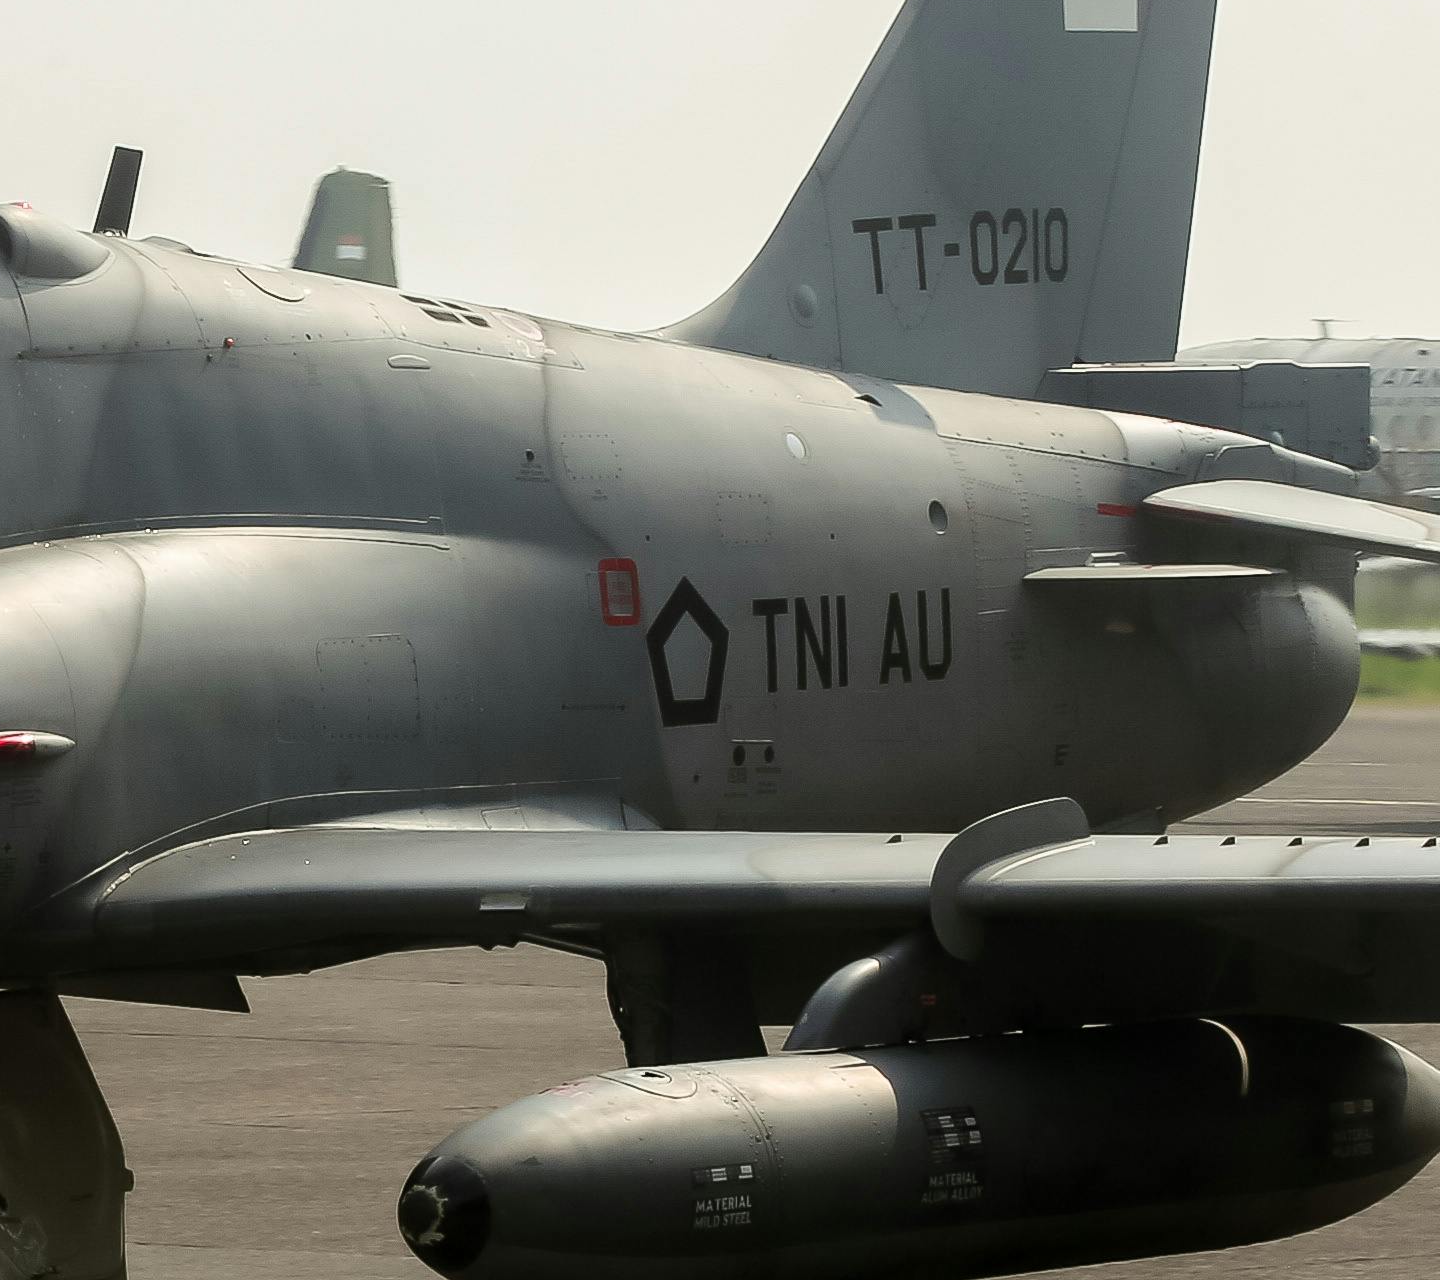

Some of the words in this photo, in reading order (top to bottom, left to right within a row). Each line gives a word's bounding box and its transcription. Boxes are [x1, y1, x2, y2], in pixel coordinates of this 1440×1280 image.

[851, 207, 1069, 295] TT-0210
[752, 594, 849, 693] TNI
[879, 587, 952, 685] AU
[695, 1194, 753, 1213] MATERIAL
[928, 1171, 979, 1187] MATERIAL
